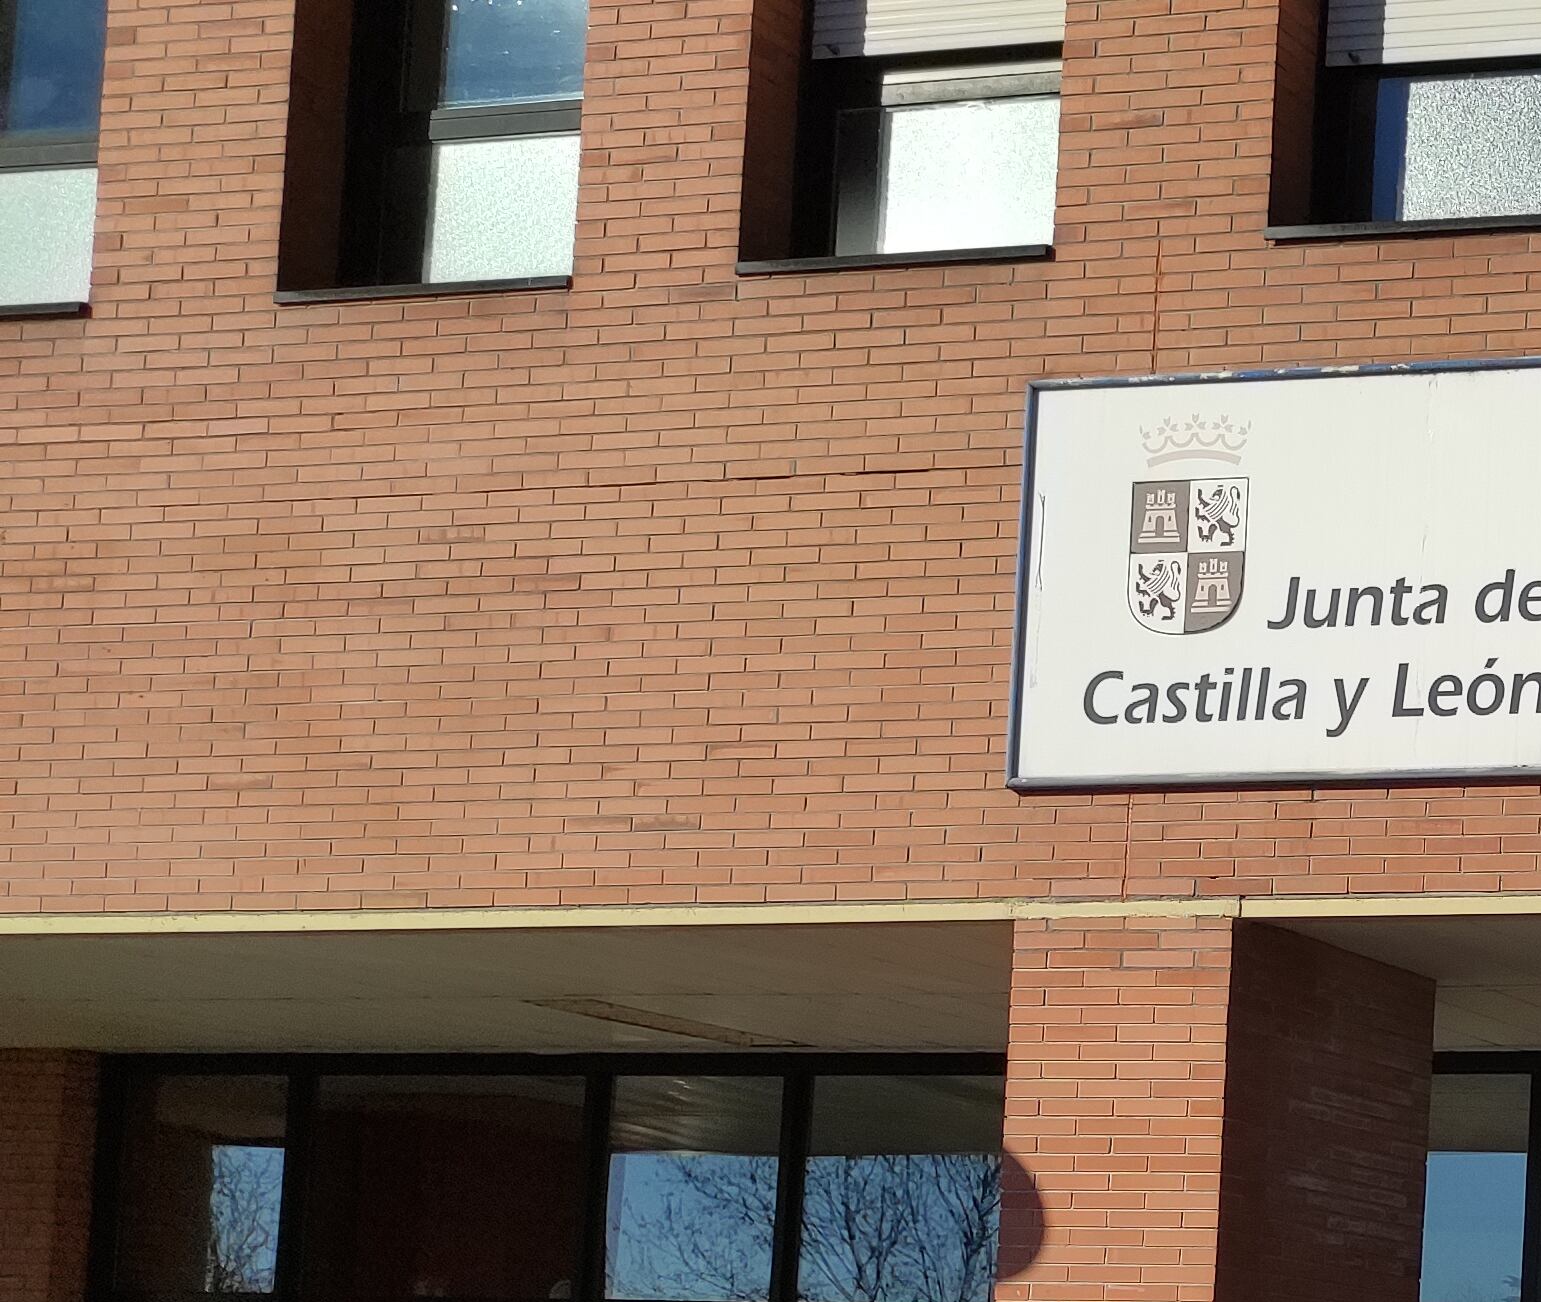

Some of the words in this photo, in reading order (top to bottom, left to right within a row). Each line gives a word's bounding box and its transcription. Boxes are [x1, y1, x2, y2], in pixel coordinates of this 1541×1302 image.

[1268, 577, 1448, 629] Junta
[1084, 667, 1306, 724] Castilla
[1326, 680, 1357, 737] y
